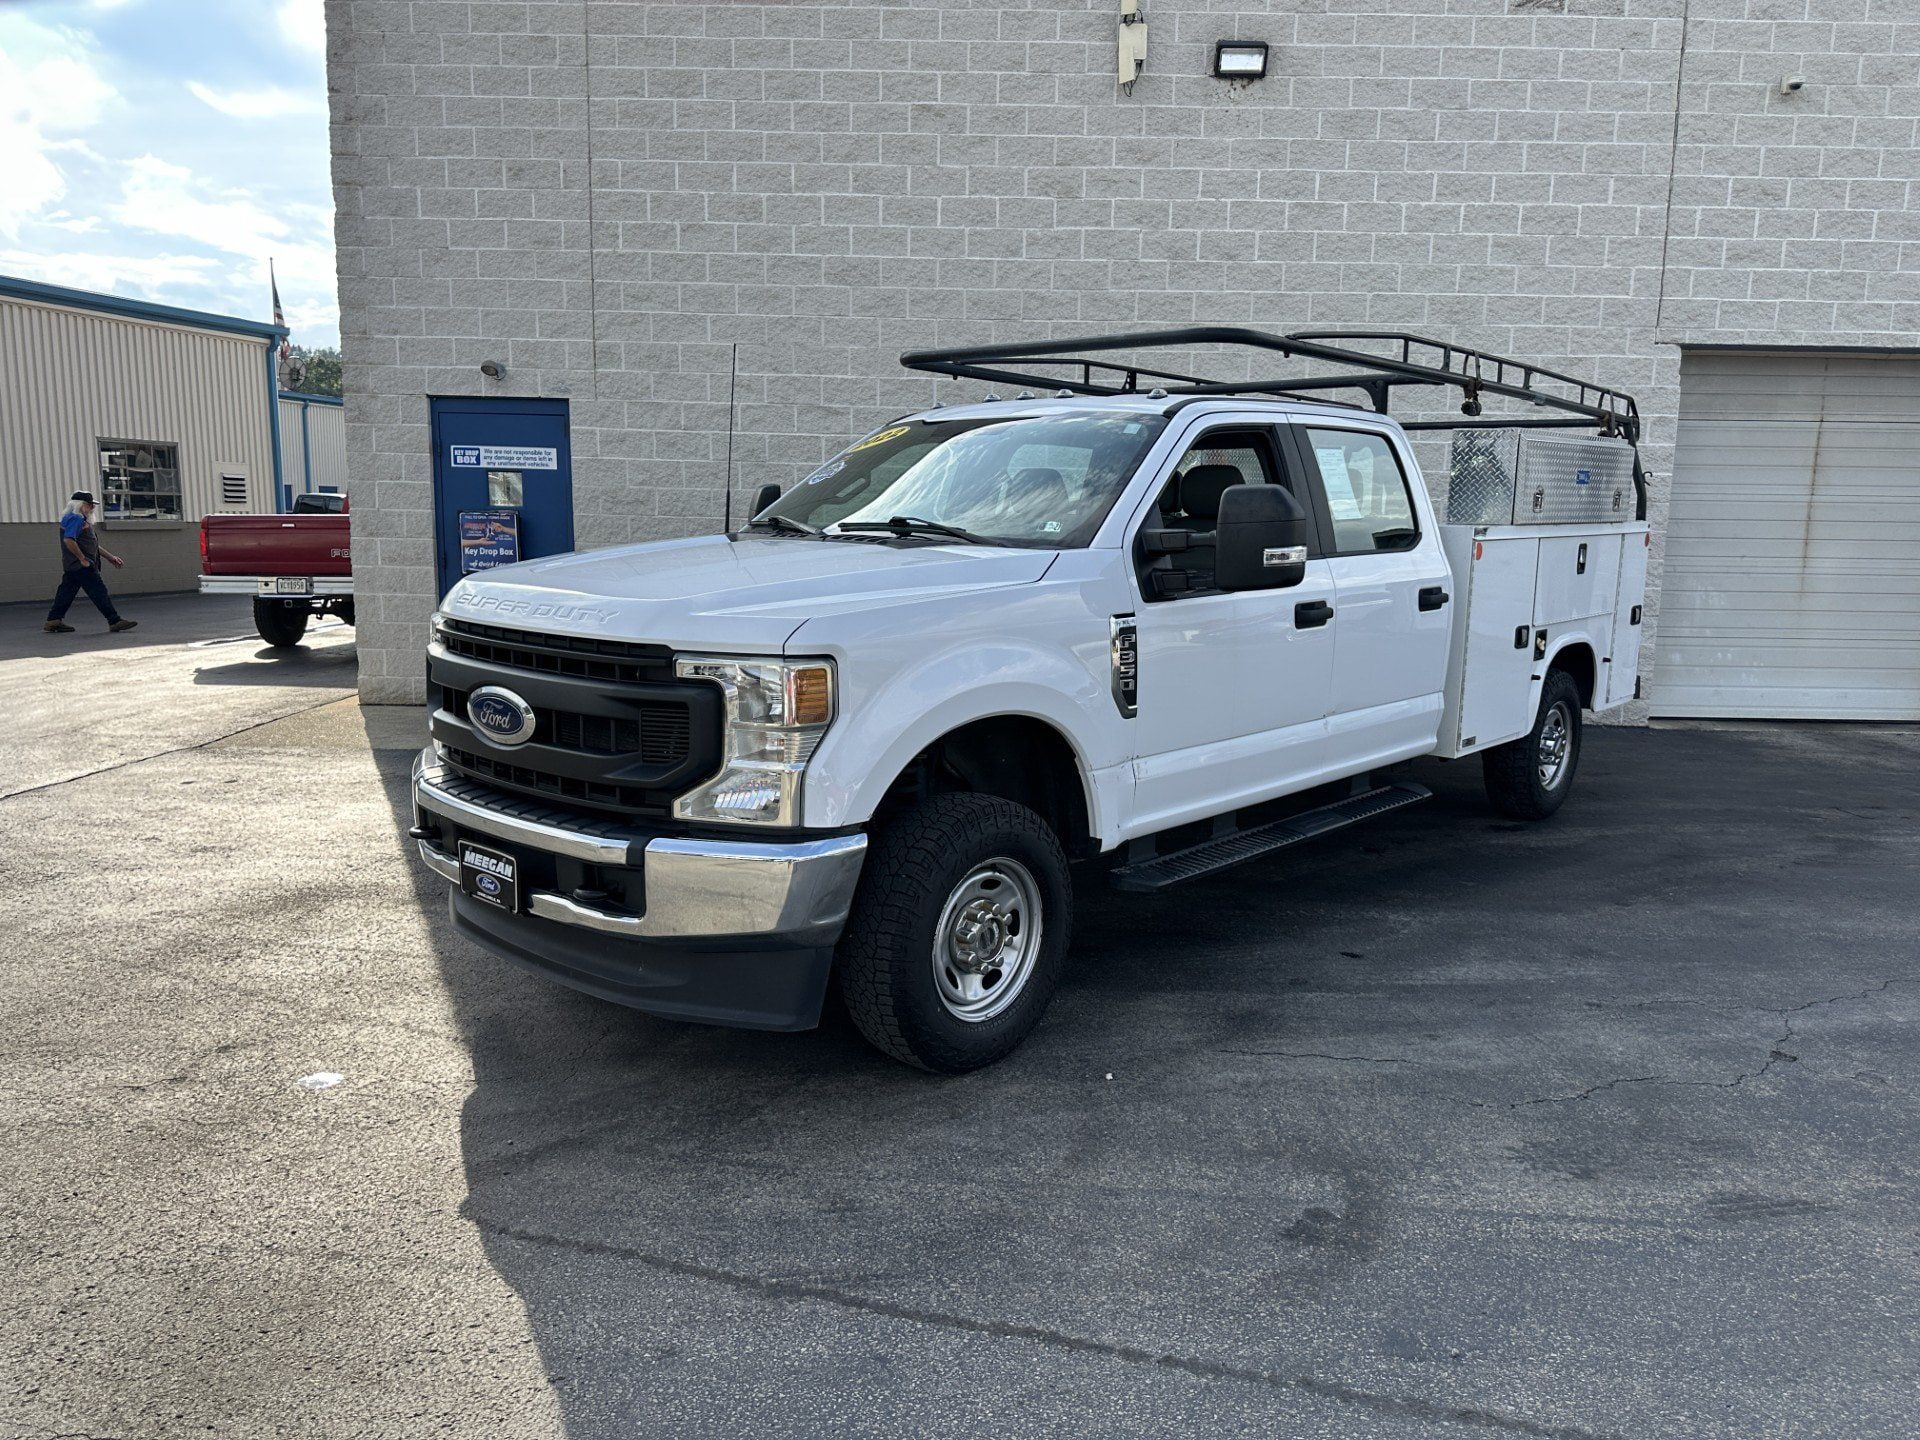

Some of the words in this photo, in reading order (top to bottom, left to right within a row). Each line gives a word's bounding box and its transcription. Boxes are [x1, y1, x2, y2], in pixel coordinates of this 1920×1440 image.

[456, 455, 477, 464] BOX
[464, 547, 479, 557] Key
[479, 547, 498, 557] Drop
[499, 547, 514, 556] Box
[456, 593, 531, 616] SUPER
[531, 603, 621, 624] DUTY
[480, 700, 512, 729] Ford
[464, 850, 513, 878] MEEGAN
[481, 877, 496, 891] Ford
